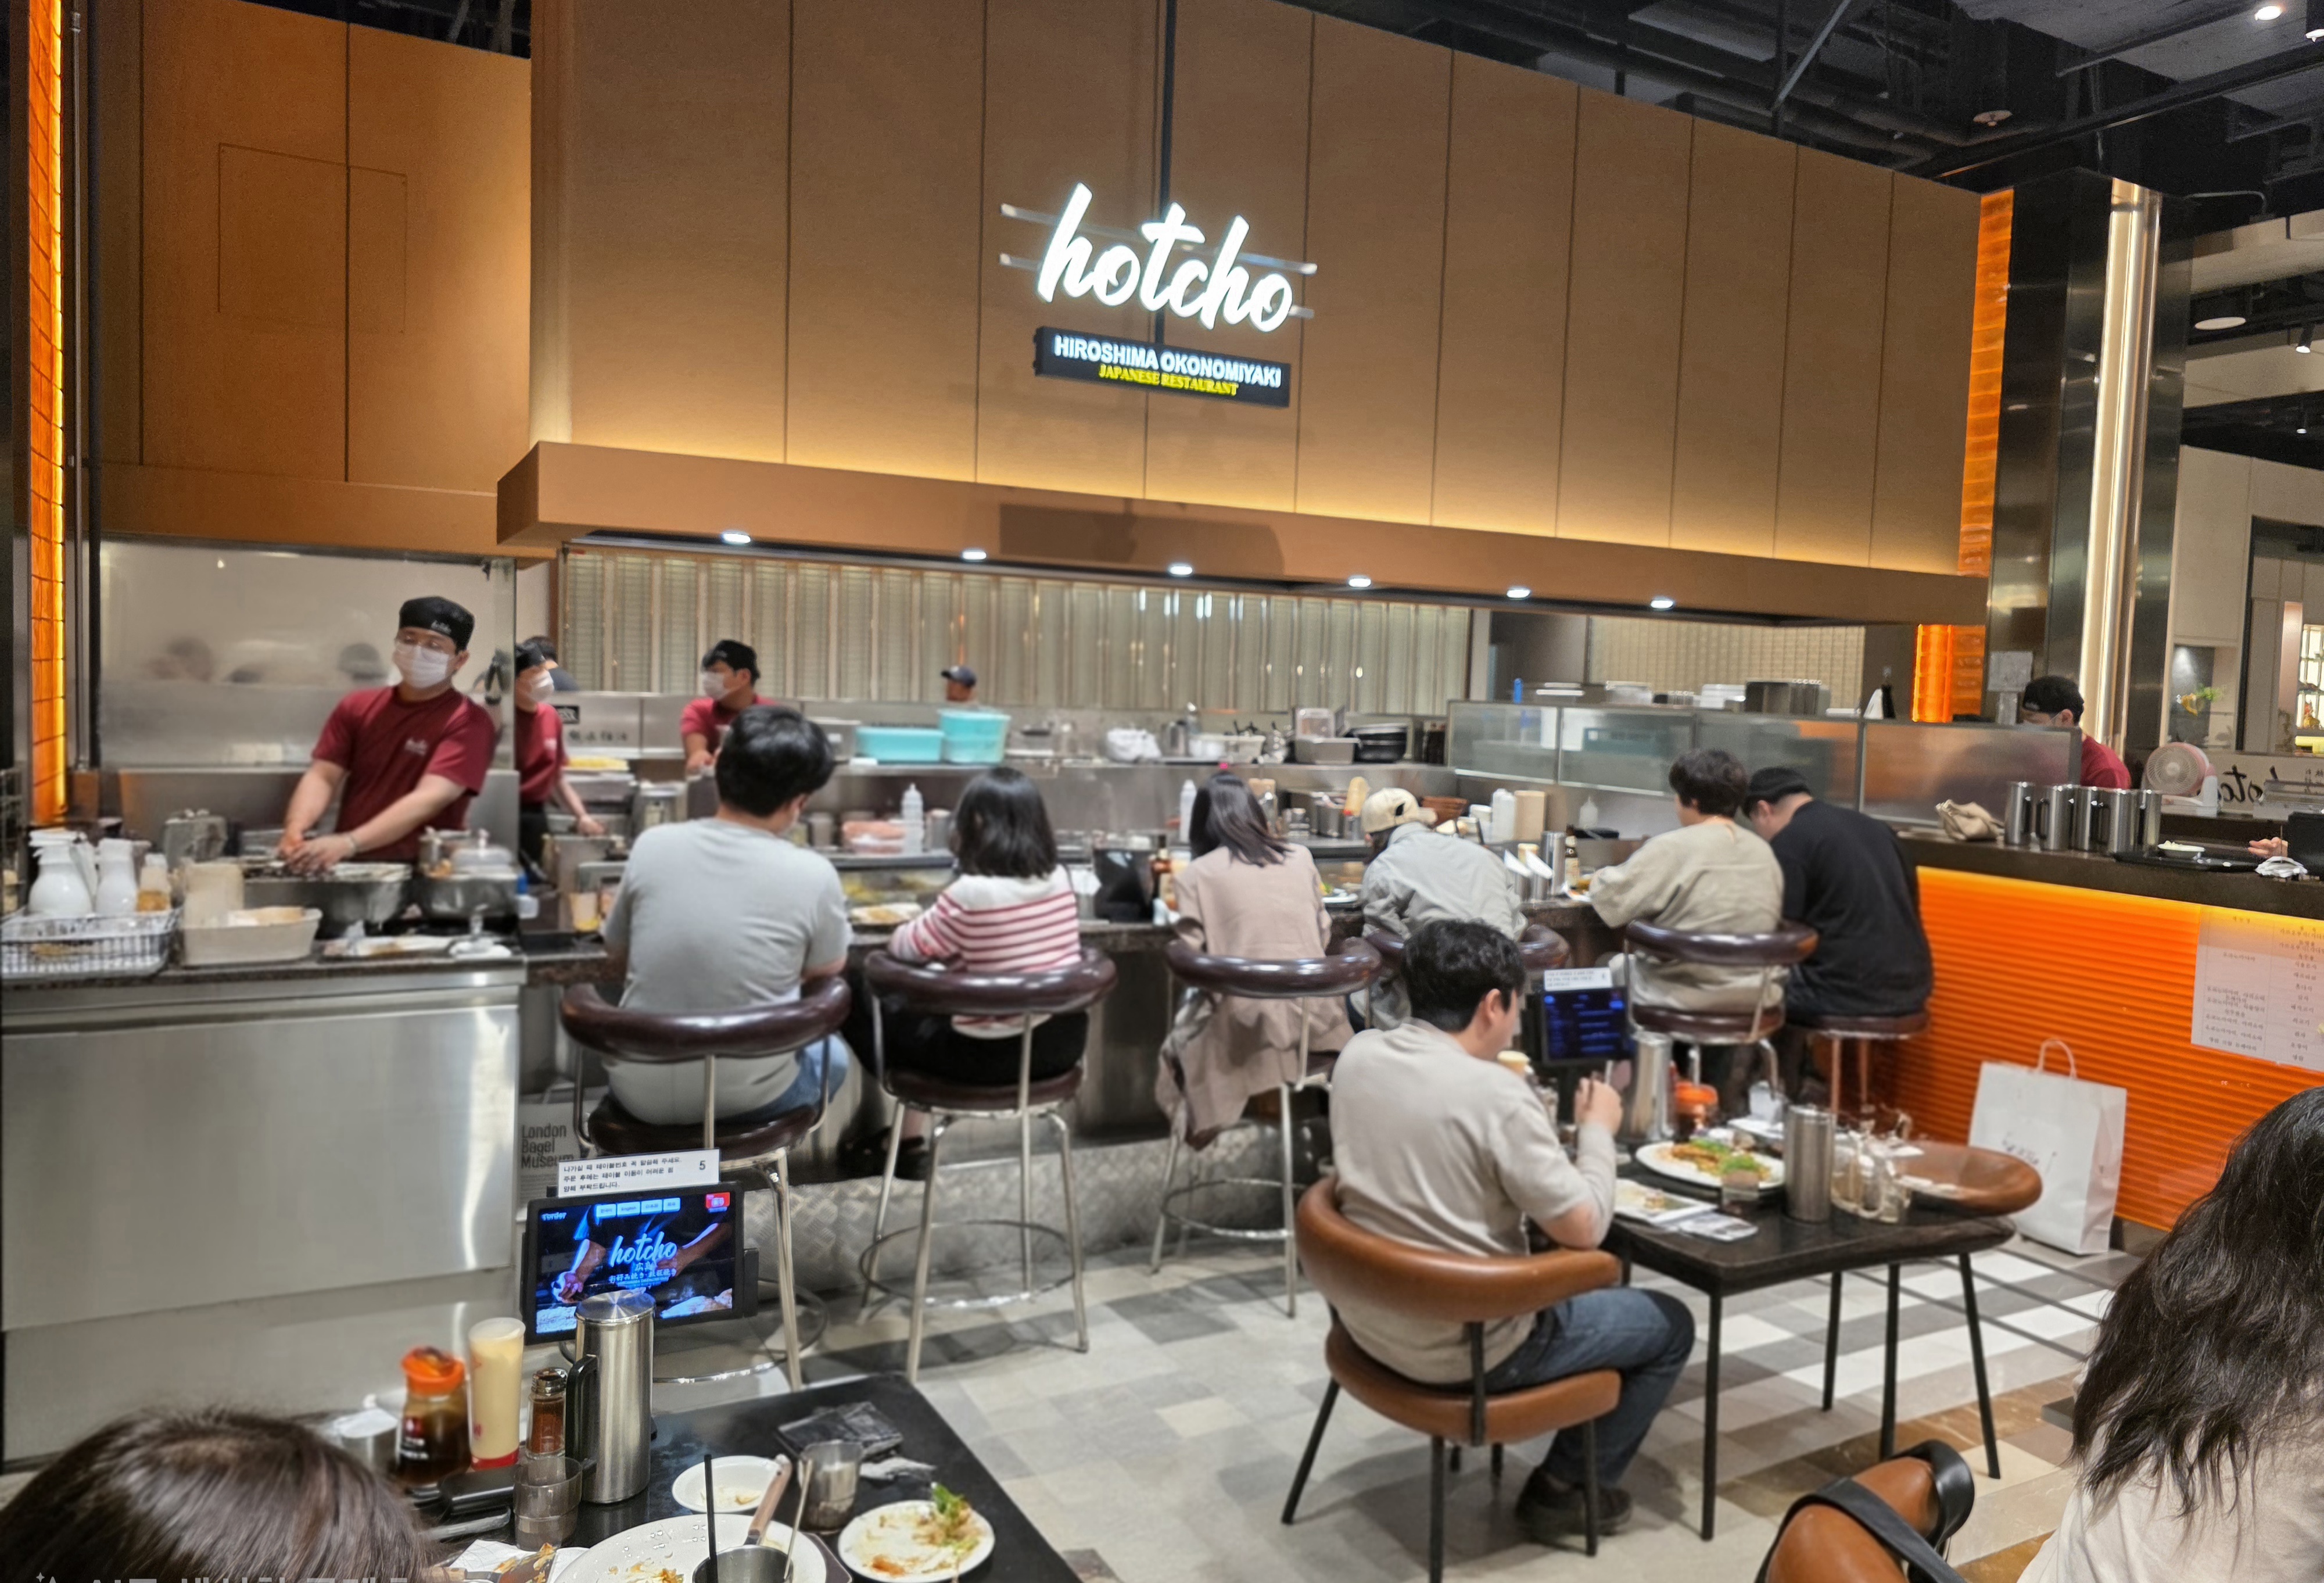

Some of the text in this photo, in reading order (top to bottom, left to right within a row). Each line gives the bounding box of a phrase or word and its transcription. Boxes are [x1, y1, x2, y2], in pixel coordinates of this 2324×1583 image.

[1038, 181, 1293, 333] hotcho
[1053, 335, 1282, 388] HIROSHIMA OKONOMIYAKI
[1099, 364, 1239, 396] JAPANESE RESTAURANT
[522, 1123, 567, 1138] London
[522, 1138, 556, 1156] Bagel
[699, 1160, 706, 1170] 5
[609, 1231, 677, 1267] hotcho
